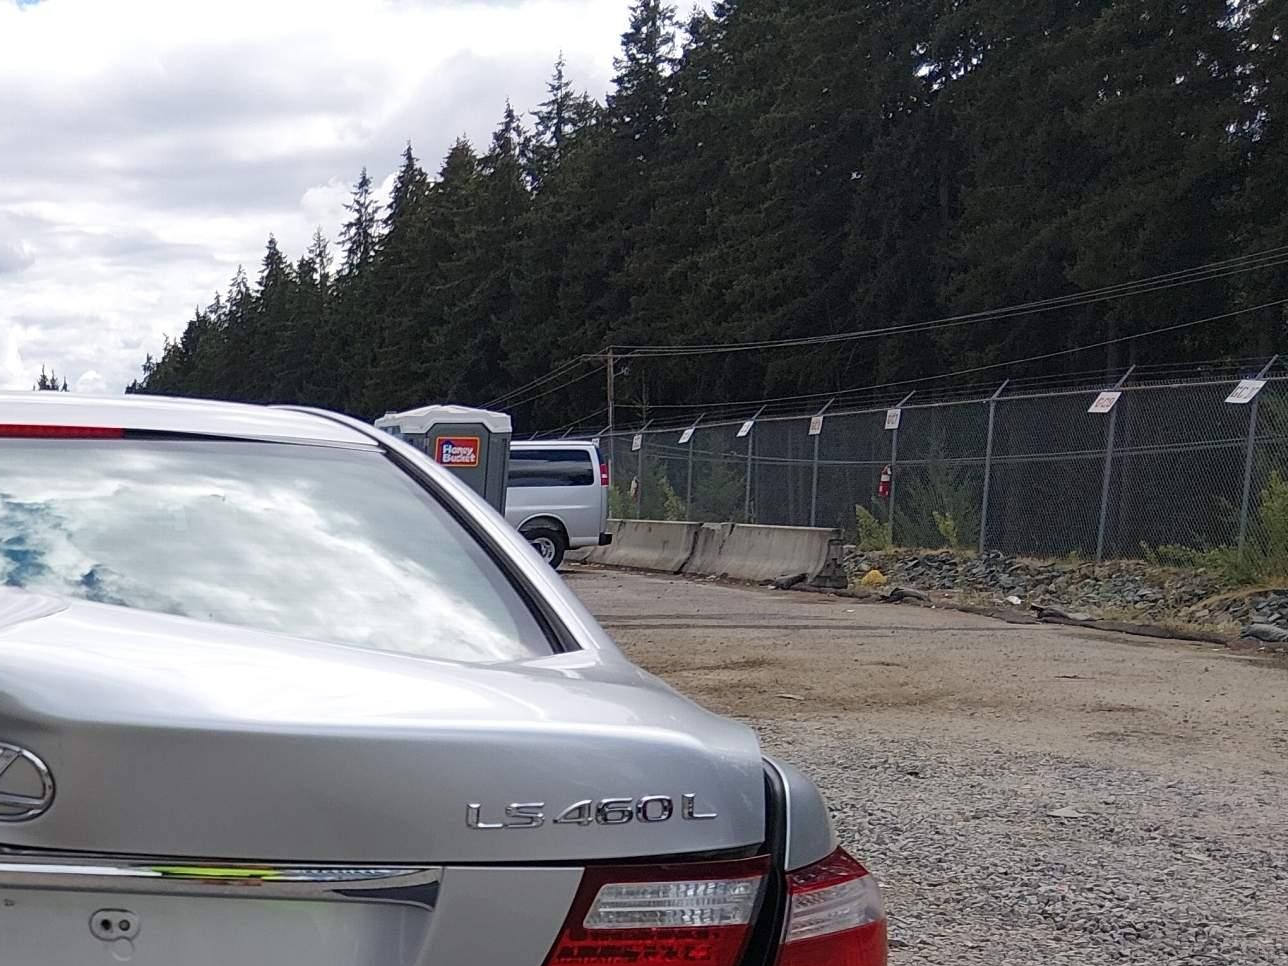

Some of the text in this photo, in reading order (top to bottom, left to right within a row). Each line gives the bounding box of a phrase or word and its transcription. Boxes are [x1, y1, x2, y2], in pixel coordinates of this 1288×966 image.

[443, 444, 474, 456] Honey
[443, 453, 476, 463] Bucket
[466, 802, 544, 829] LS
[552, 795, 674, 827] 460
